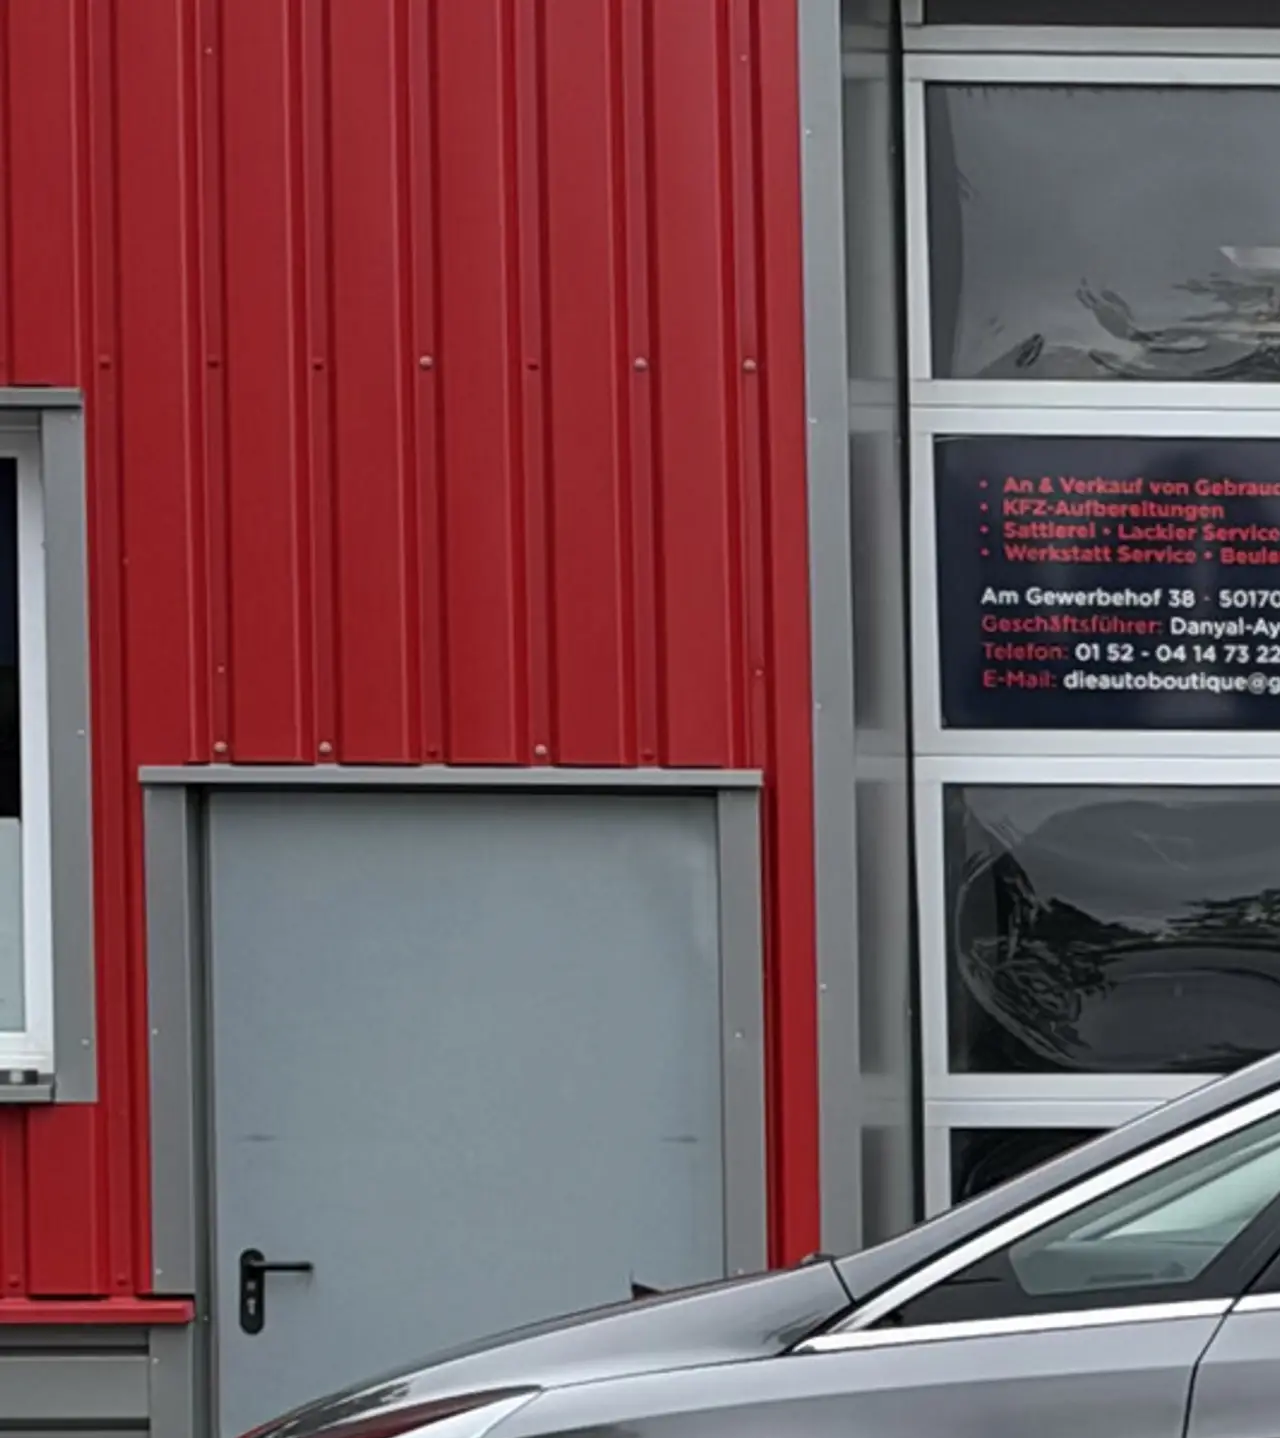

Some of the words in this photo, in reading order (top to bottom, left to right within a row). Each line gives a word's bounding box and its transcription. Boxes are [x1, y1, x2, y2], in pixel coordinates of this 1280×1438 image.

[1003, 476, 1033, 493] An
[1039, 477, 1054, 493] &
[1059, 476, 1143, 495] Verkauf
[1149, 481, 1189, 495] von
[1003, 499, 1225, 521] KFZ-Aufbereitungen
[1003, 521, 1096, 540] Sattlerei
[1118, 523, 1196, 541] Lackier
[1202, 523, 1280, 542] Service
[1004, 544, 1112, 562] Werkstatt
[1117, 545, 1196, 564] Service
[981, 587, 1019, 605] Am
[1025, 587, 1162, 607] Gewerbehof
[1168, 589, 1196, 608] 38
[981, 613, 1163, 634] Geschäftsführer:
[983, 642, 1069, 660] Telefon:
[1074, 644, 1100, 661] 01
[1106, 644, 1134, 661] 52
[1155, 644, 1186, 662] 04
[1193, 644, 1217, 663] 14
[1224, 645, 1249, 663] 73
[982, 670, 1057, 688] E-Mail:
